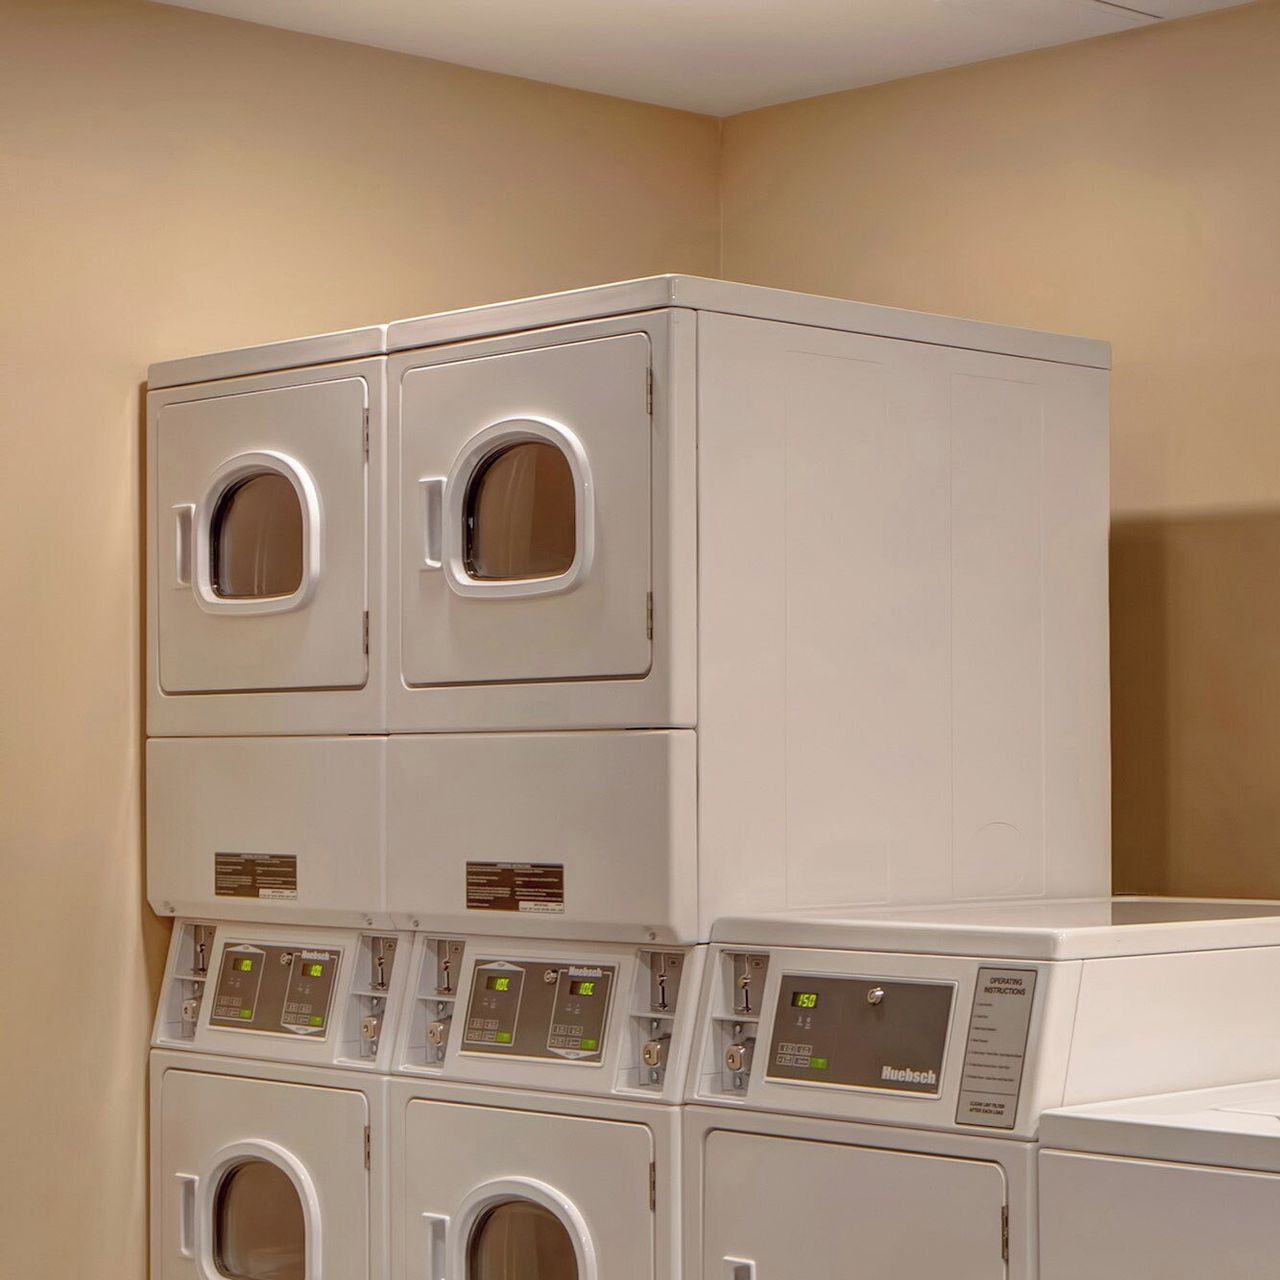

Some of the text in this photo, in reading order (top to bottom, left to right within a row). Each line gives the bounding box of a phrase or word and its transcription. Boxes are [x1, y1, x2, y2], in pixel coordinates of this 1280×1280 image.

[990, 977, 1022, 985] OPERATING
[984, 987, 1026, 995] INSTRUCTIONS
[798, 995, 816, 1007] 150
[881, 1066, 936, 1084] Huebsch
